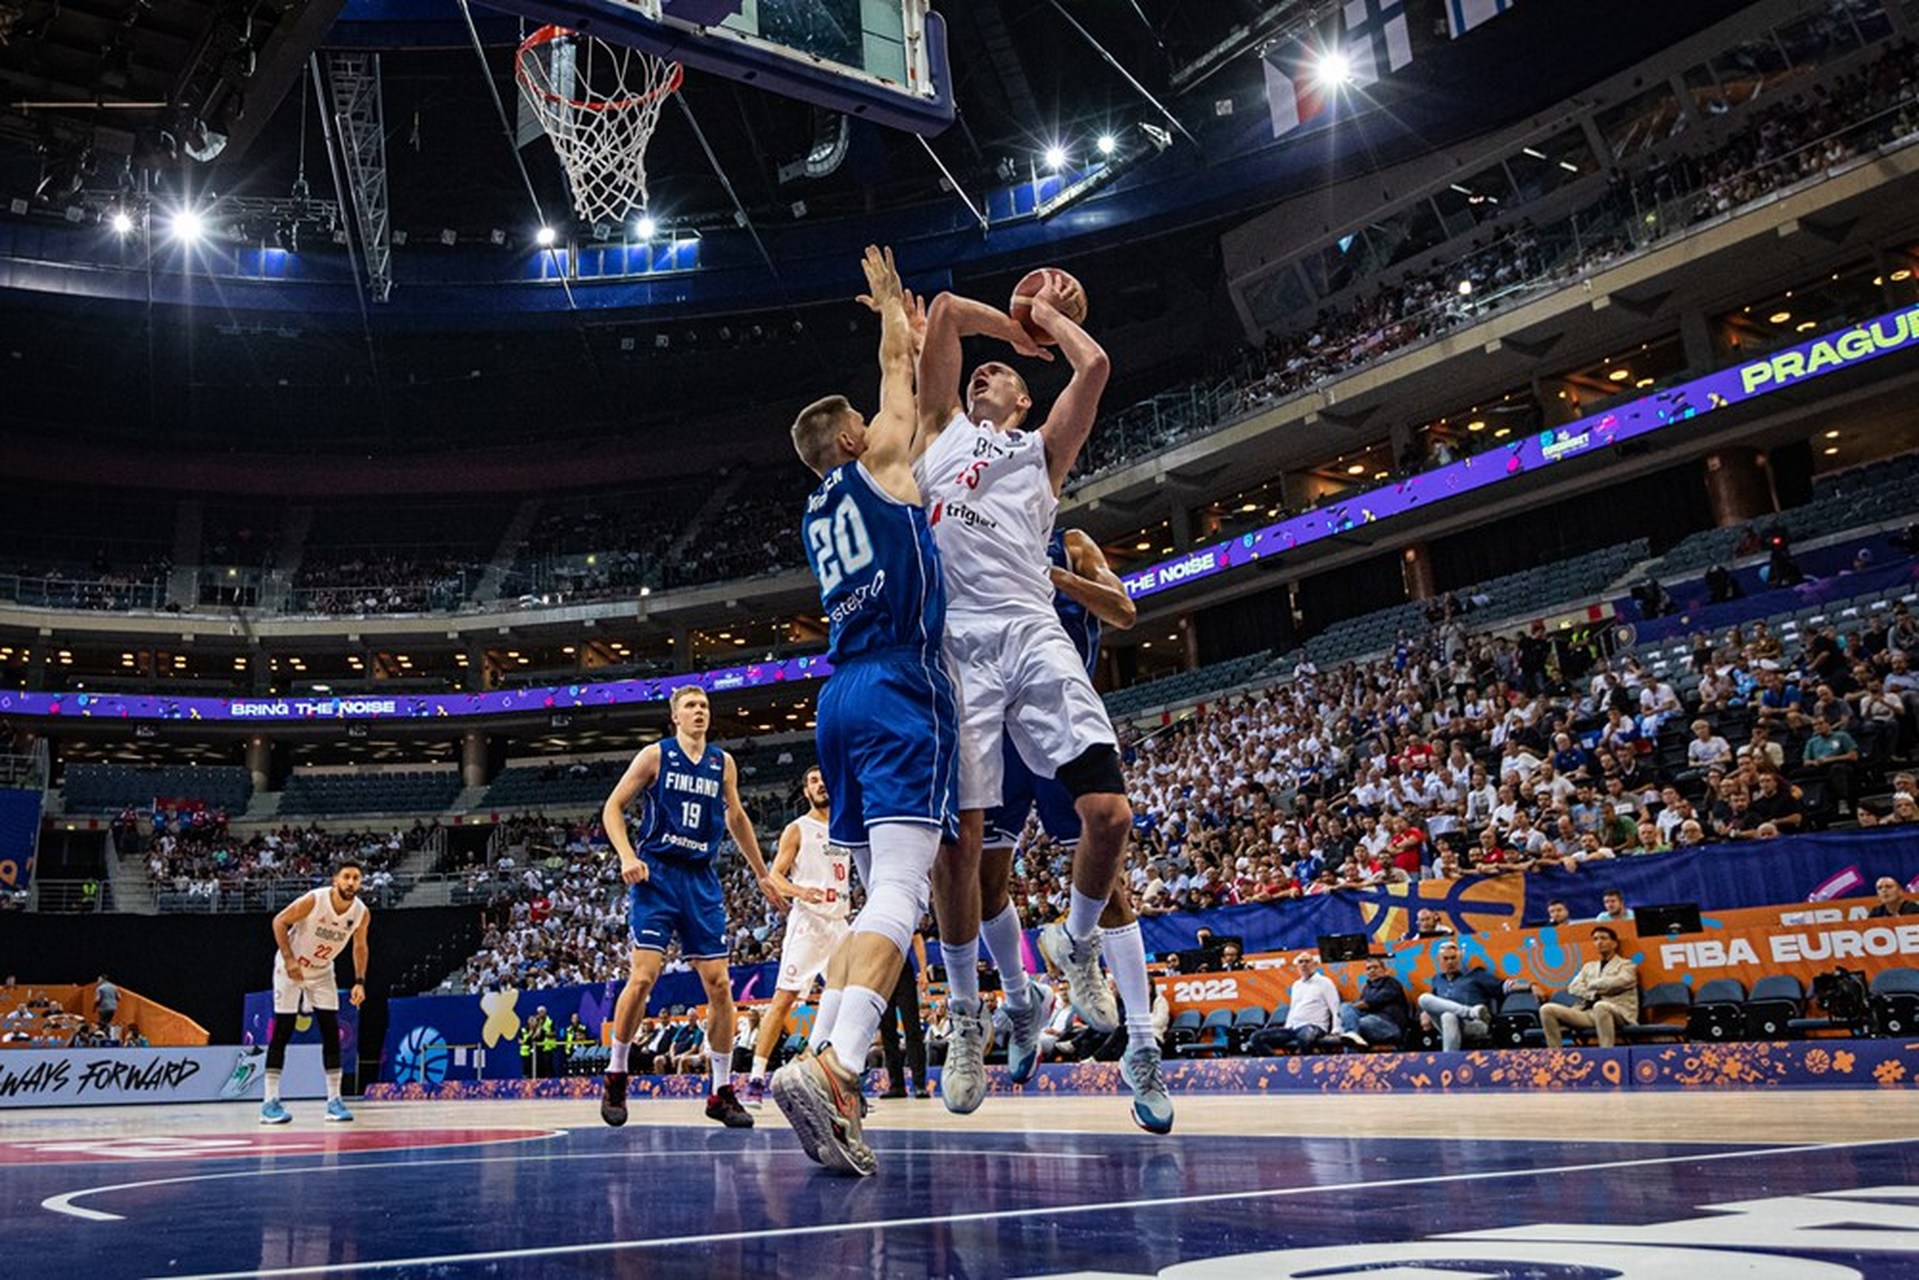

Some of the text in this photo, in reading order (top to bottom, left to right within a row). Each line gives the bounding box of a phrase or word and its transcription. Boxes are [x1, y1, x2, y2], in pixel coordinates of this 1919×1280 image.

[808, 493, 874, 597] 20
[1160, 552, 1215, 584] NOISE
[231, 701, 396, 716] BRING THE NOISE
[665, 771, 719, 799] FINLAND
[681, 801, 702, 829] 19
[832, 862, 846, 881] 10
[314, 944, 333, 960] 22
[1659, 937, 1760, 970] FIBA
[1173, 978, 1239, 1003] 2022
[77, 1056, 200, 1095] FORWARD
